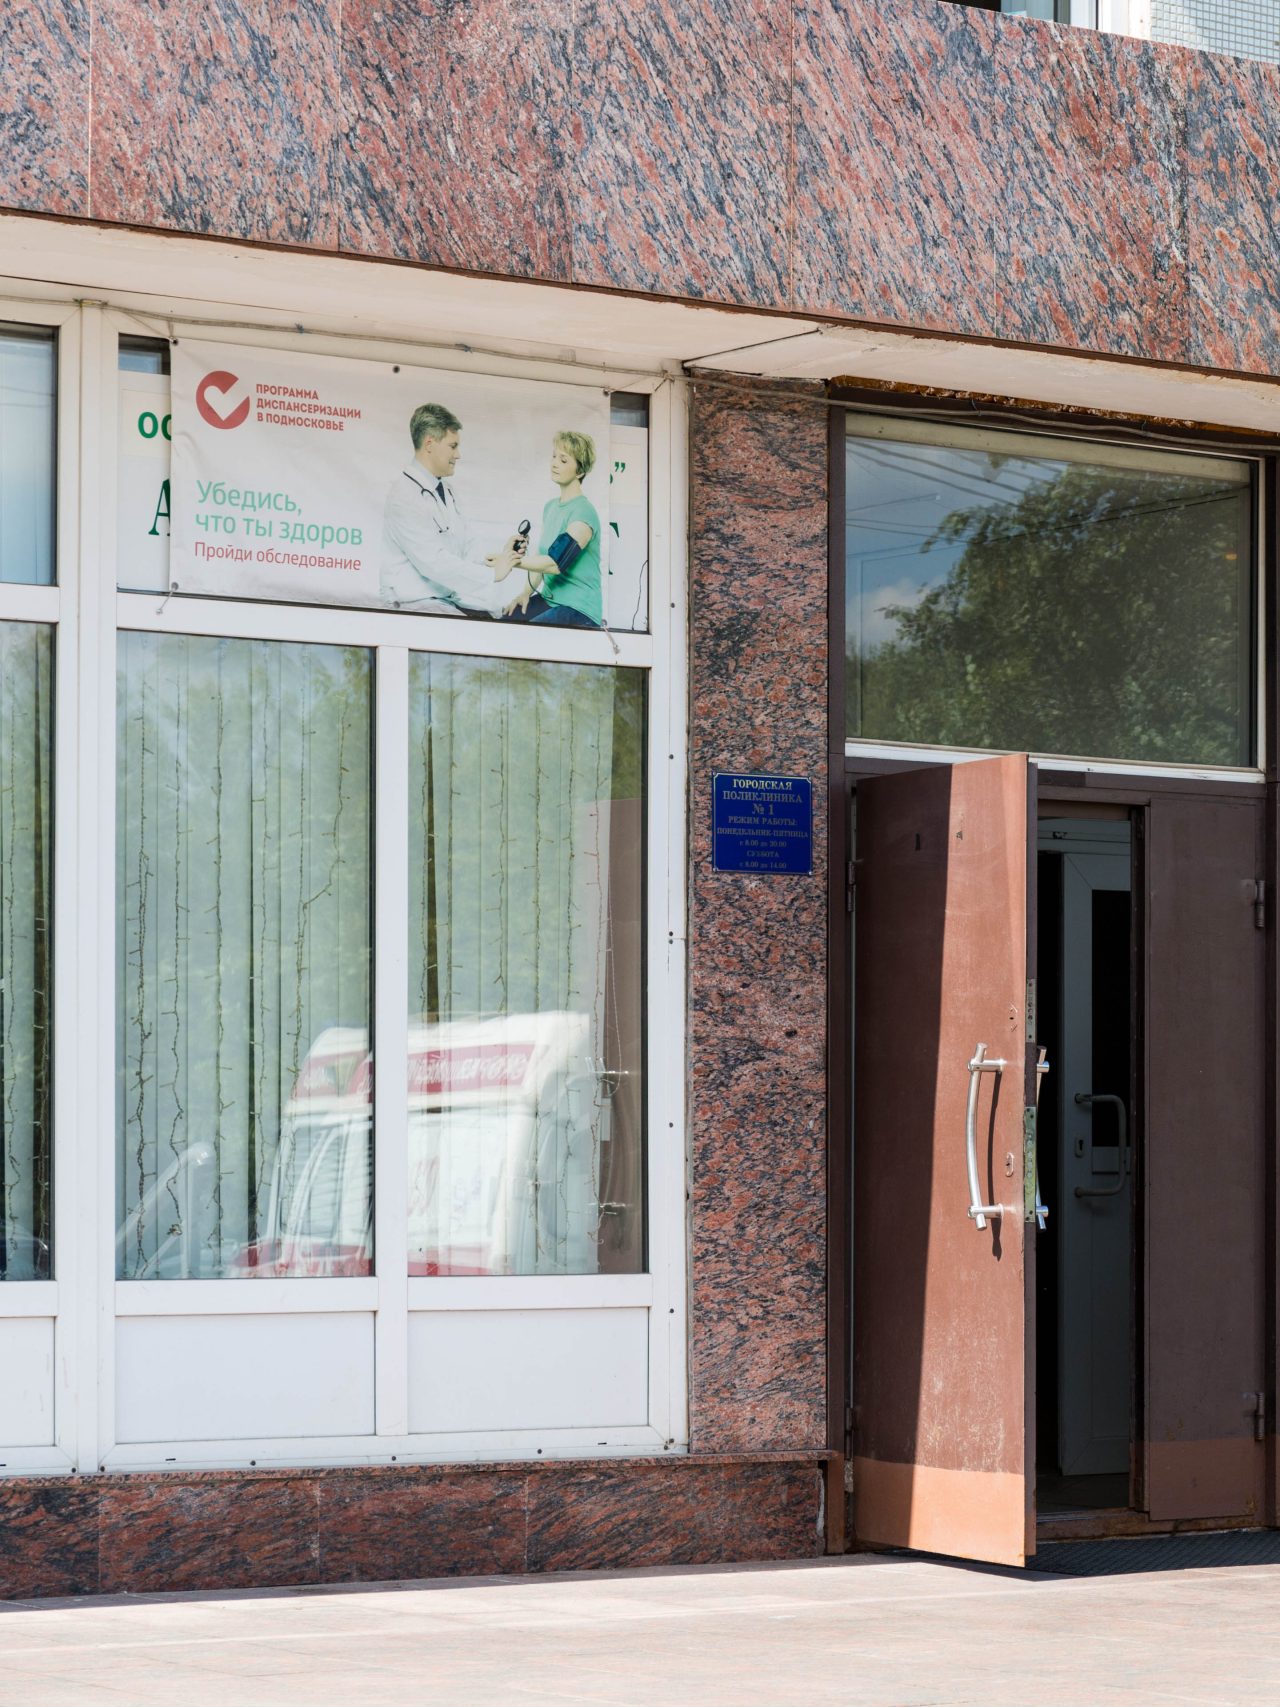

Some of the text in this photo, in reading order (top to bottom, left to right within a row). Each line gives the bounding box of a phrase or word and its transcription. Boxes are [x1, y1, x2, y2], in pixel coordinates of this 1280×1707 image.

[256, 384, 319, 400] ПРОГРАММА
[257, 398, 361, 419] ДИСПАНСЕРИЗАЦИИ
[257, 412, 344, 431] В ПОДМОСКОВЬЕ
[196, 480, 302, 516] Убедись,
[195, 514, 363, 549] что ты здоров
[194, 541, 361, 571] Пройди обследование
[733, 779, 792, 791] ГОРОДСКАЯ
[723, 791, 803, 803] ПОЛИКЛИНИКА
[752, 803, 774, 815] № 1
[728, 816, 798, 825] РЕЖИМ РАБОТЫ:
[717, 827, 808, 838] ПОНЕДЕЛЬНИК-ПЯТНИЦА
[747, 850, 780, 858] СУББОТА
